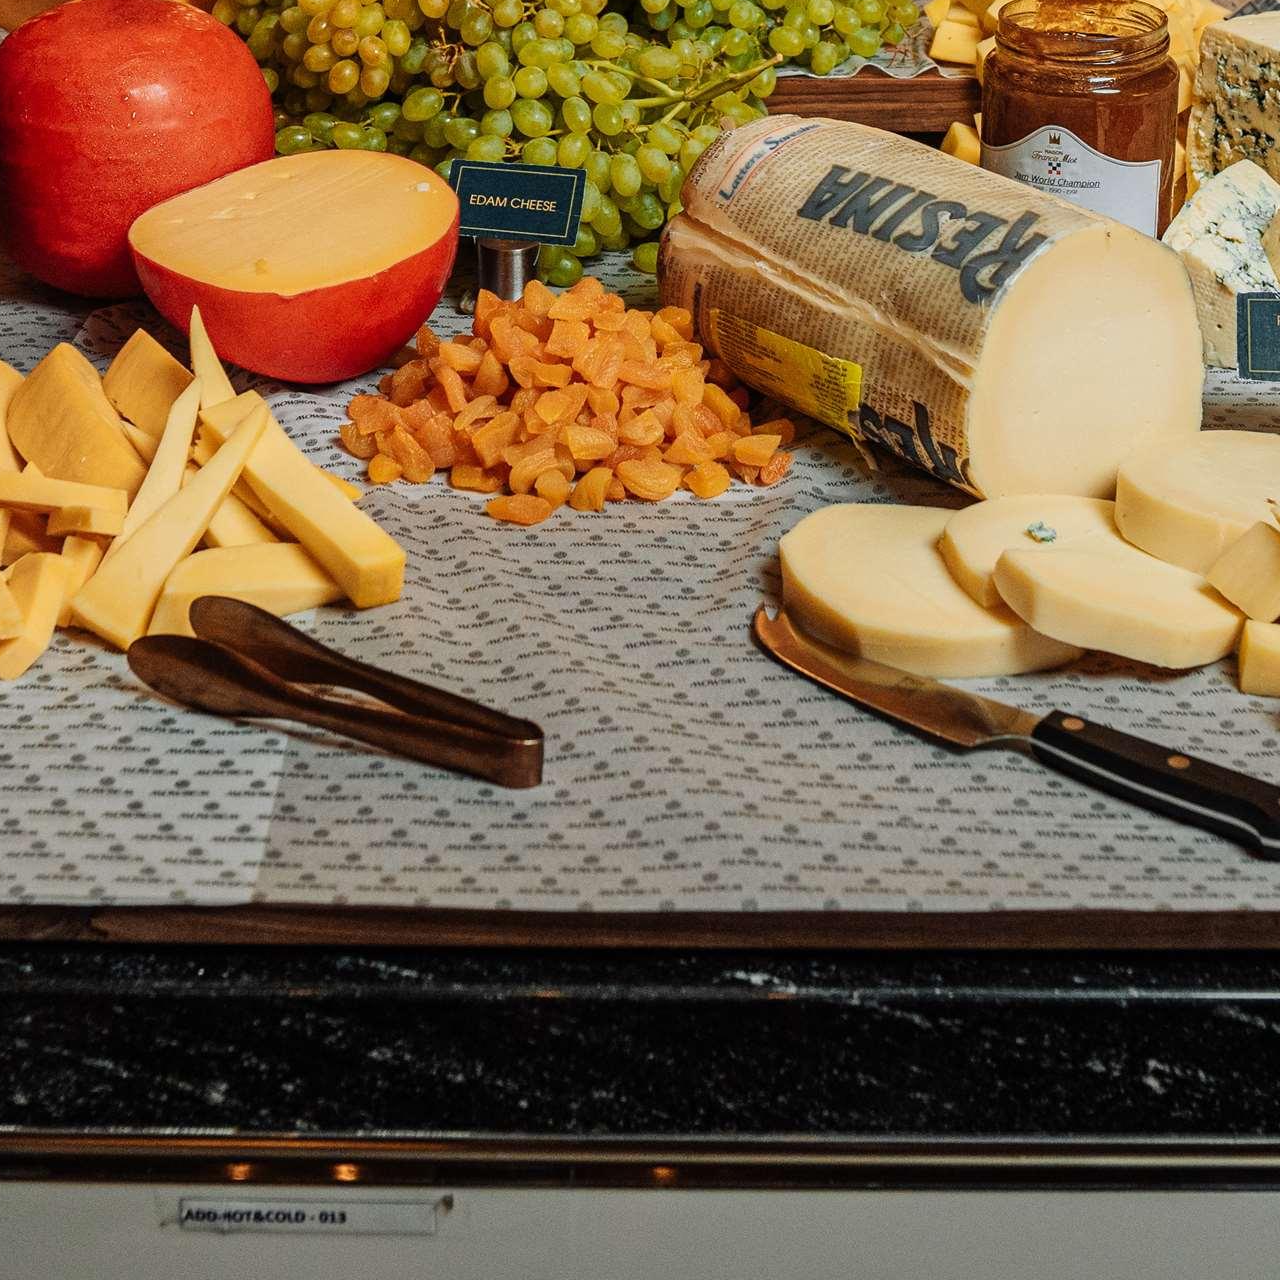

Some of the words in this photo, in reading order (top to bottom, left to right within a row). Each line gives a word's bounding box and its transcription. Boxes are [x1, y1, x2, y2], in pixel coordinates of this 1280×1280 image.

[1015, 171, 1029, 183] Jam
[1031, 175, 1057, 188] World
[1057, 177, 1101, 190] Champion
[469, 194, 508, 207] EDAM
[510, 198, 557, 212] CHEESE
[797, 164, 1048, 304] RESINA
[319, 1210, 348, 1224] 013
